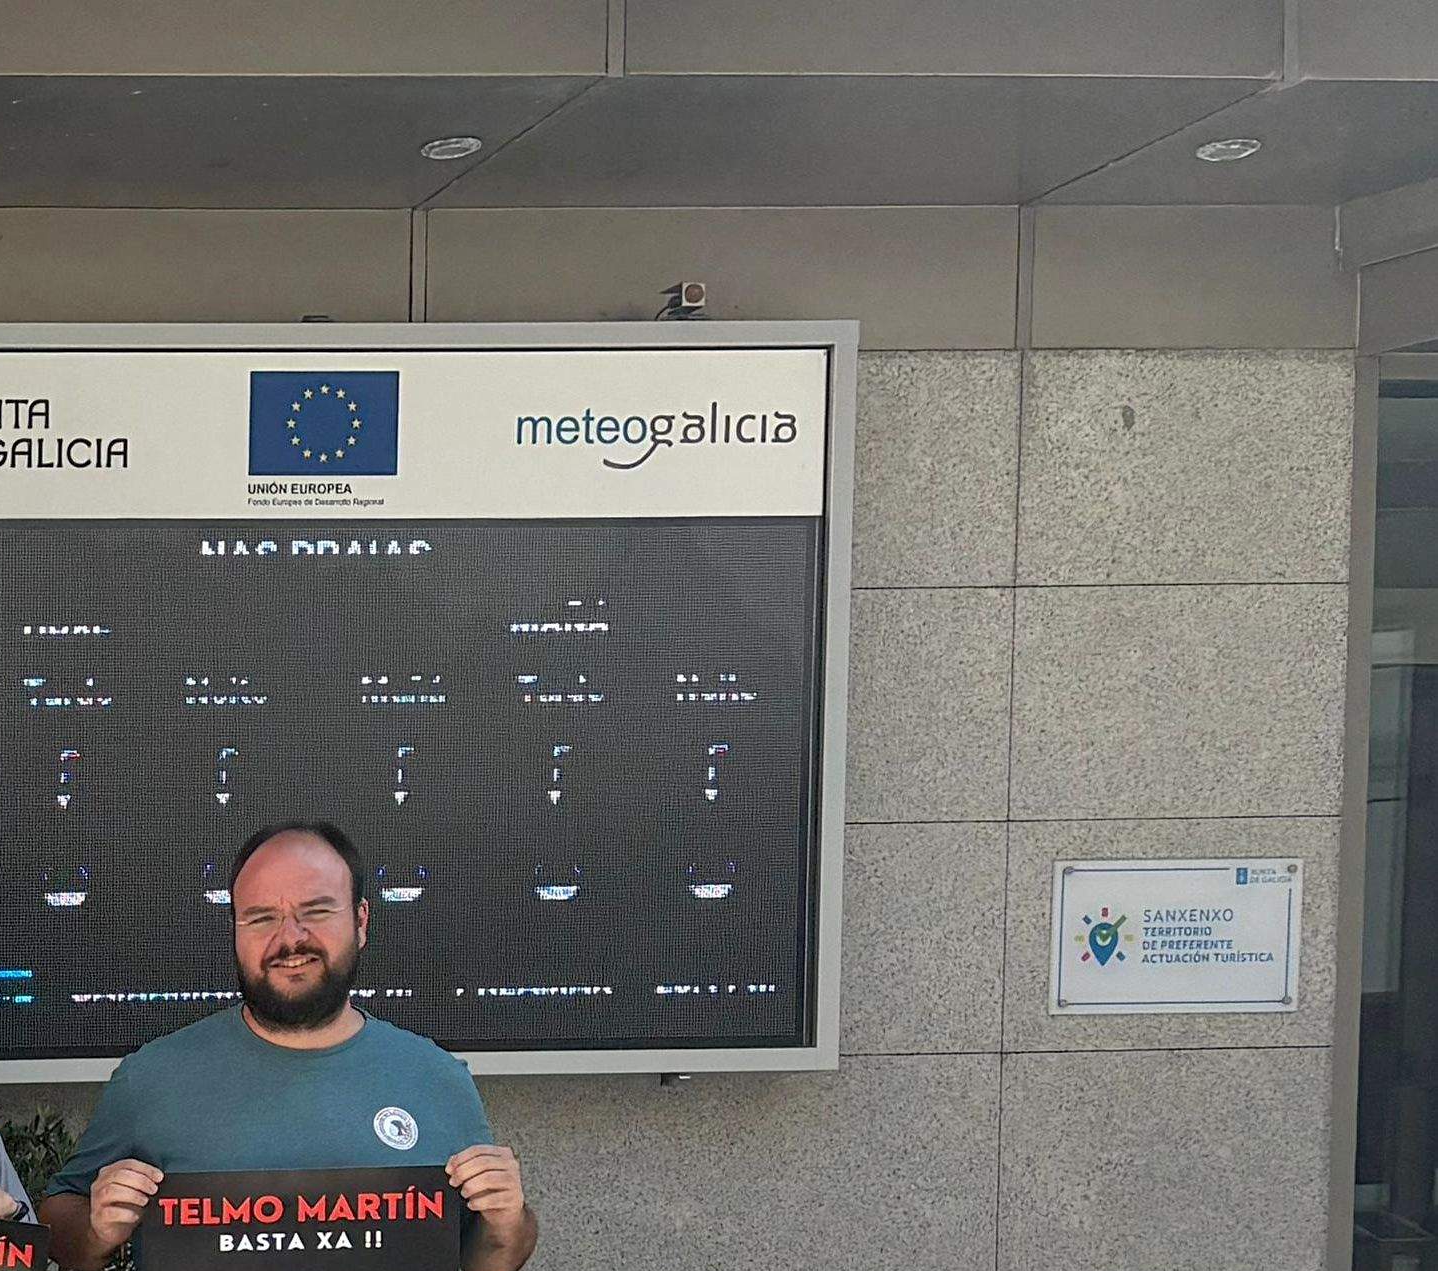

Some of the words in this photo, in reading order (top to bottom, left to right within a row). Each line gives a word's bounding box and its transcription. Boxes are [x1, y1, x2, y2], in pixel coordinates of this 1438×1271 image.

[516, 401, 797, 469] meteogalicia
[247, 482, 287, 494] UNIÓN
[291, 483, 353, 495] EUROPEA
[1143, 908, 1234, 922] SANXENXO
[1143, 926, 1212, 937] TERRITORIO
[1142, 940, 1158, 950] DE
[1160, 939, 1233, 950] PREFERENTE
[1142, 951, 1210, 963] ACTUACIÓN
[1213, 951, 1274, 963] TURÍSTICA
[159, 1194, 285, 1227] TELMO
[297, 1185, 445, 1224] MARTÍN
[219, 1232, 305, 1252] BASTA
[316, 1231, 353, 1250] XA
